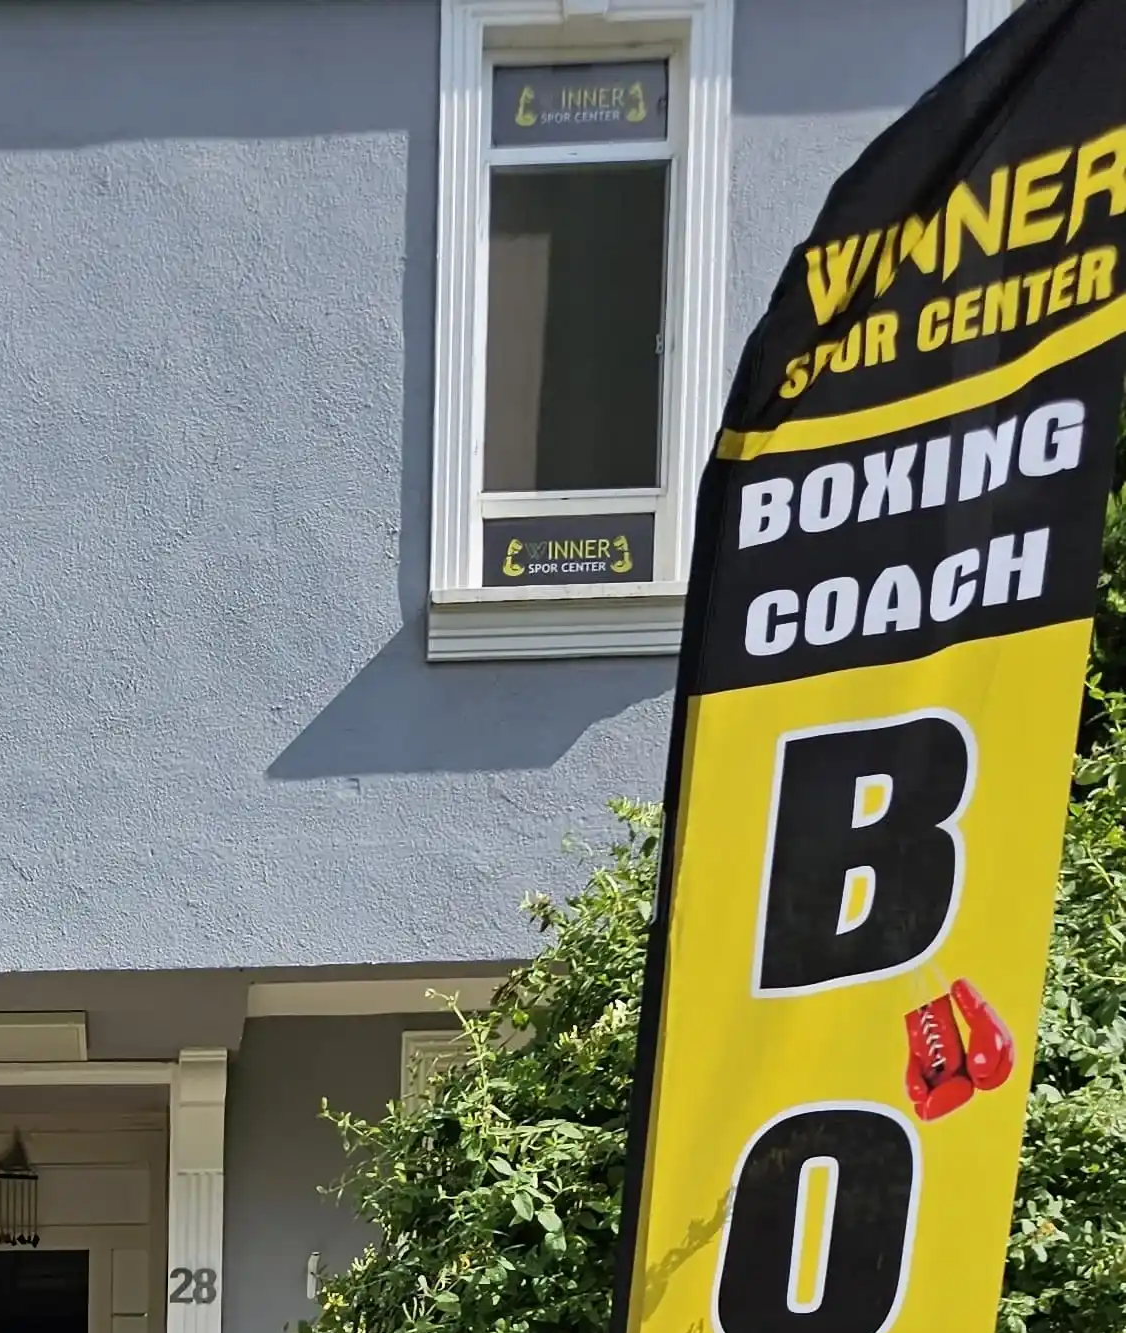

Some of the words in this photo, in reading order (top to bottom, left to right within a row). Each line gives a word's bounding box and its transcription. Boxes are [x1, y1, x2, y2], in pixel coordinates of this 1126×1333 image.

[541, 86, 624, 108] INNER
[540, 111, 570, 125] SPOR
[574, 110, 620, 123] CENTER
[806, 124, 1126, 325] WINNER
[779, 312, 898, 399] SPOR
[916, 245, 1117, 353] CENTER
[739, 400, 1085, 549] BOXING
[525, 539, 610, 560] WINNER
[528, 563, 558, 574] SPOR
[561, 562, 606, 572] CENTER
[744, 528, 1050, 656] COACH
[169, 1267, 217, 1304] 28
